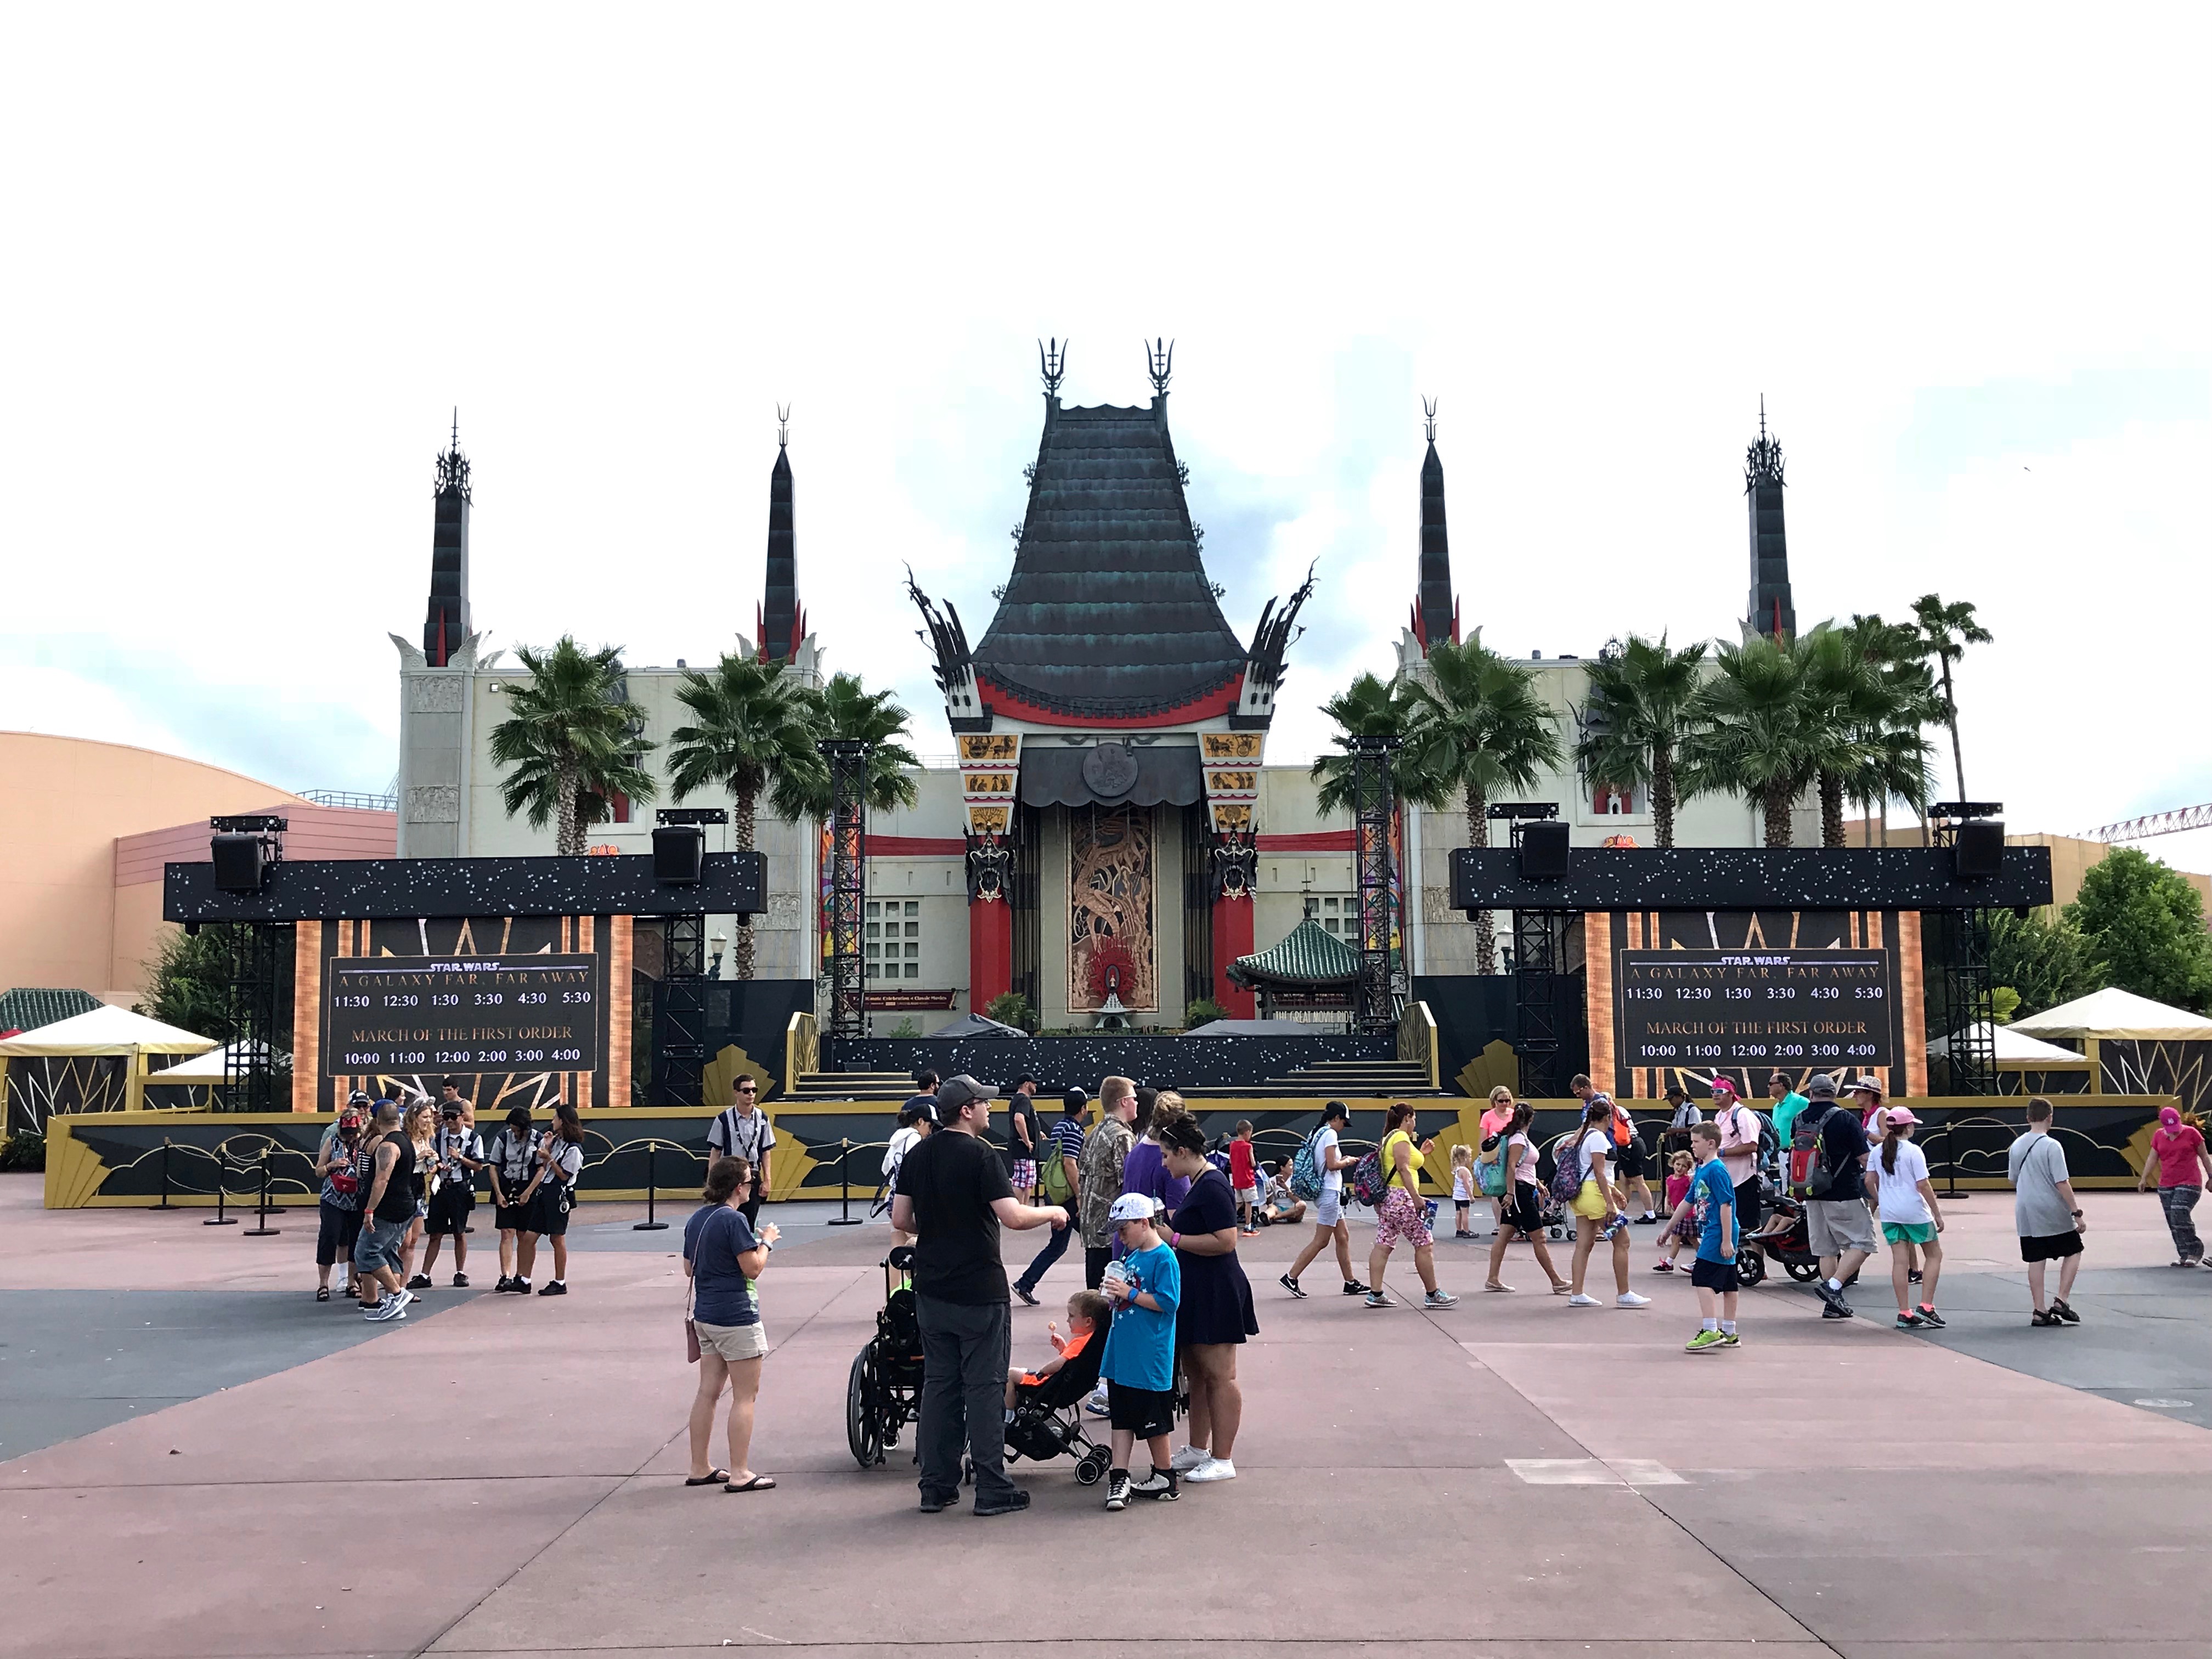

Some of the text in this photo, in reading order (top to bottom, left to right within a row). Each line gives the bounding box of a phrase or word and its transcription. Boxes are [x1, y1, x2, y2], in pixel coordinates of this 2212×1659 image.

[1721, 956, 1791, 965] STAR WARS
[430, 962, 500, 972] STAR WARS
[1631, 968, 1640, 979] A
[1650, 967, 1726, 979] GALAXY
[1787, 967, 1820, 979] FAR
[1830, 967, 1879, 979] AWAY
[339, 976, 348, 987] A
[358, 974, 435, 986] GALAXY
[496, 973, 528, 985] FAR
[539, 972, 589, 984] AWAY
[335, 991, 591, 1007] 11:30 12:30 1:30 3:30 4:30 5:30
[1627, 987, 1883, 999] 11:30 12:30 1:30 3:30 4:30 5:30
[1276, 1011, 1355, 1023] THE GREAT MOVIE RIDE
[1646, 1021, 1867, 1034] MARCH OF THE FIRST ORDER
[352, 1026, 572, 1042] MARCH OF THE FIRST ORDER
[1640, 1044, 1876, 1056] 10:00 11:00 12:00 2:00 3:00 4:00
[345, 1049, 580, 1064] 10:00 11:00 12:00 2:00 3:00 4:00
